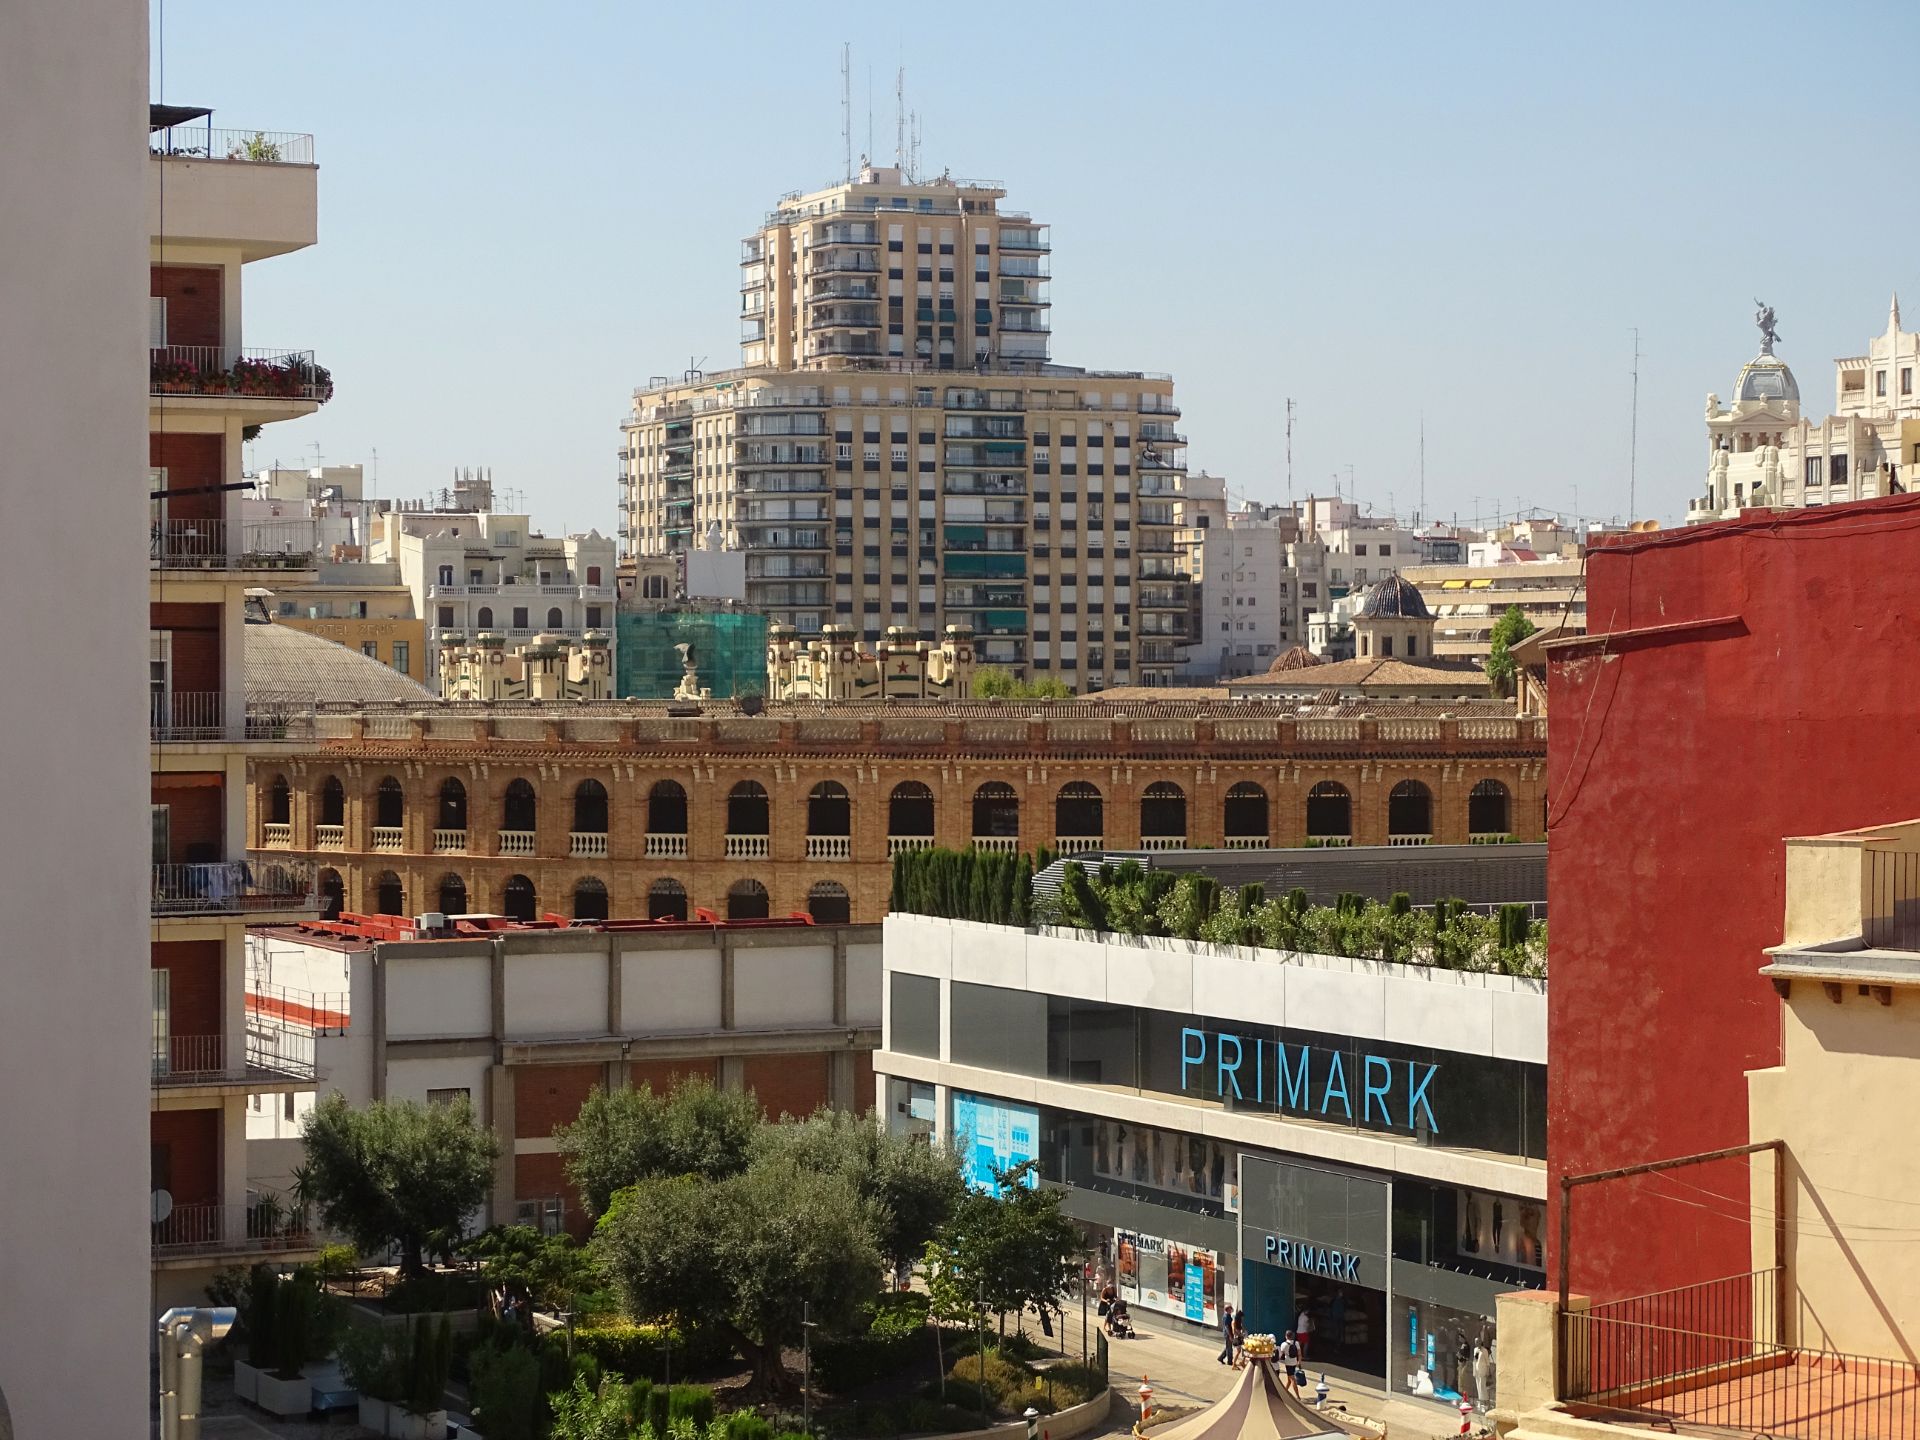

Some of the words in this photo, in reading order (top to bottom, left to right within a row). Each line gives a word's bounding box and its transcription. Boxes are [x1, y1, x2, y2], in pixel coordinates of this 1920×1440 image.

[305, 623, 350, 636] HOTEL
[1181, 1027, 1439, 1134] PRIMARK
[1265, 1235, 1360, 1282] PRIMARK
